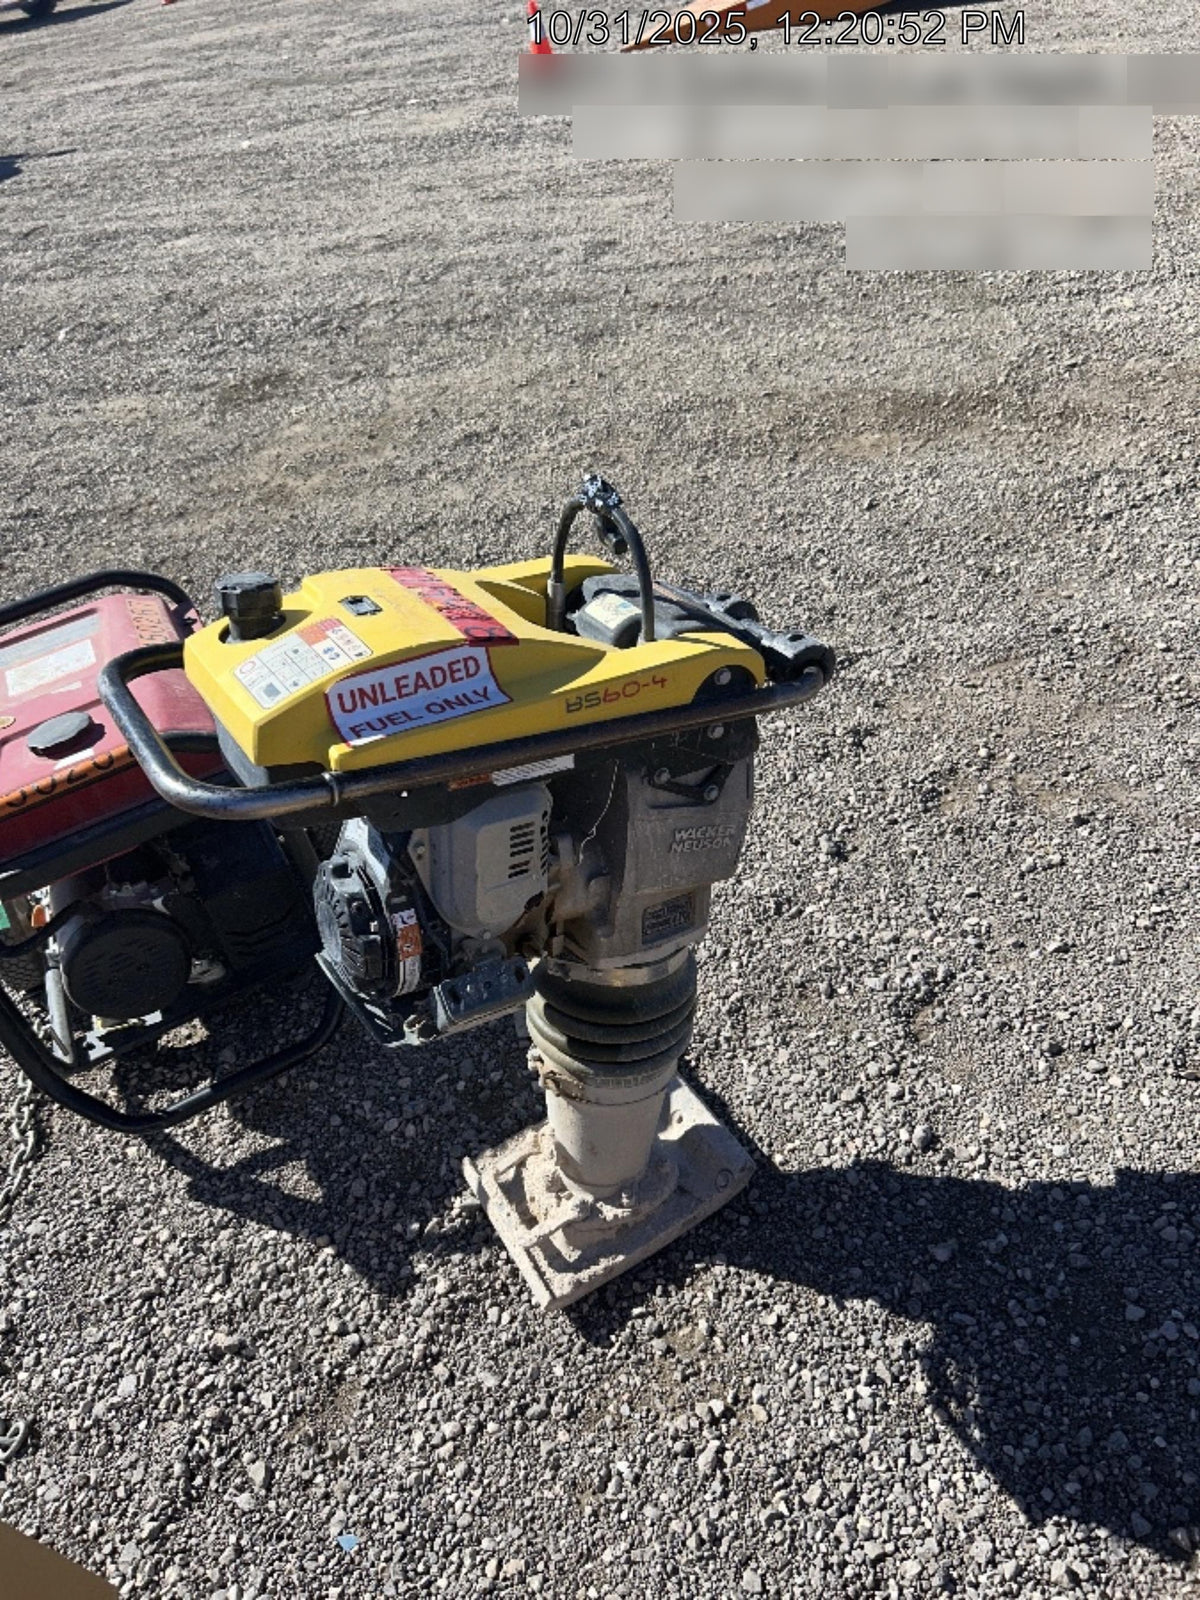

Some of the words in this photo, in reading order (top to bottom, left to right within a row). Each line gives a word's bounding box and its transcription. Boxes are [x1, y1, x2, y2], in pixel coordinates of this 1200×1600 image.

[336, 654, 481, 714] UNLEADED
[566, 674, 667, 713] BS60-4
[349, 711, 423, 739] FUEL
[427, 686, 492, 714] ONLY
[668, 837, 732, 853] NEUSON
[673, 824, 736, 842] WACKER
